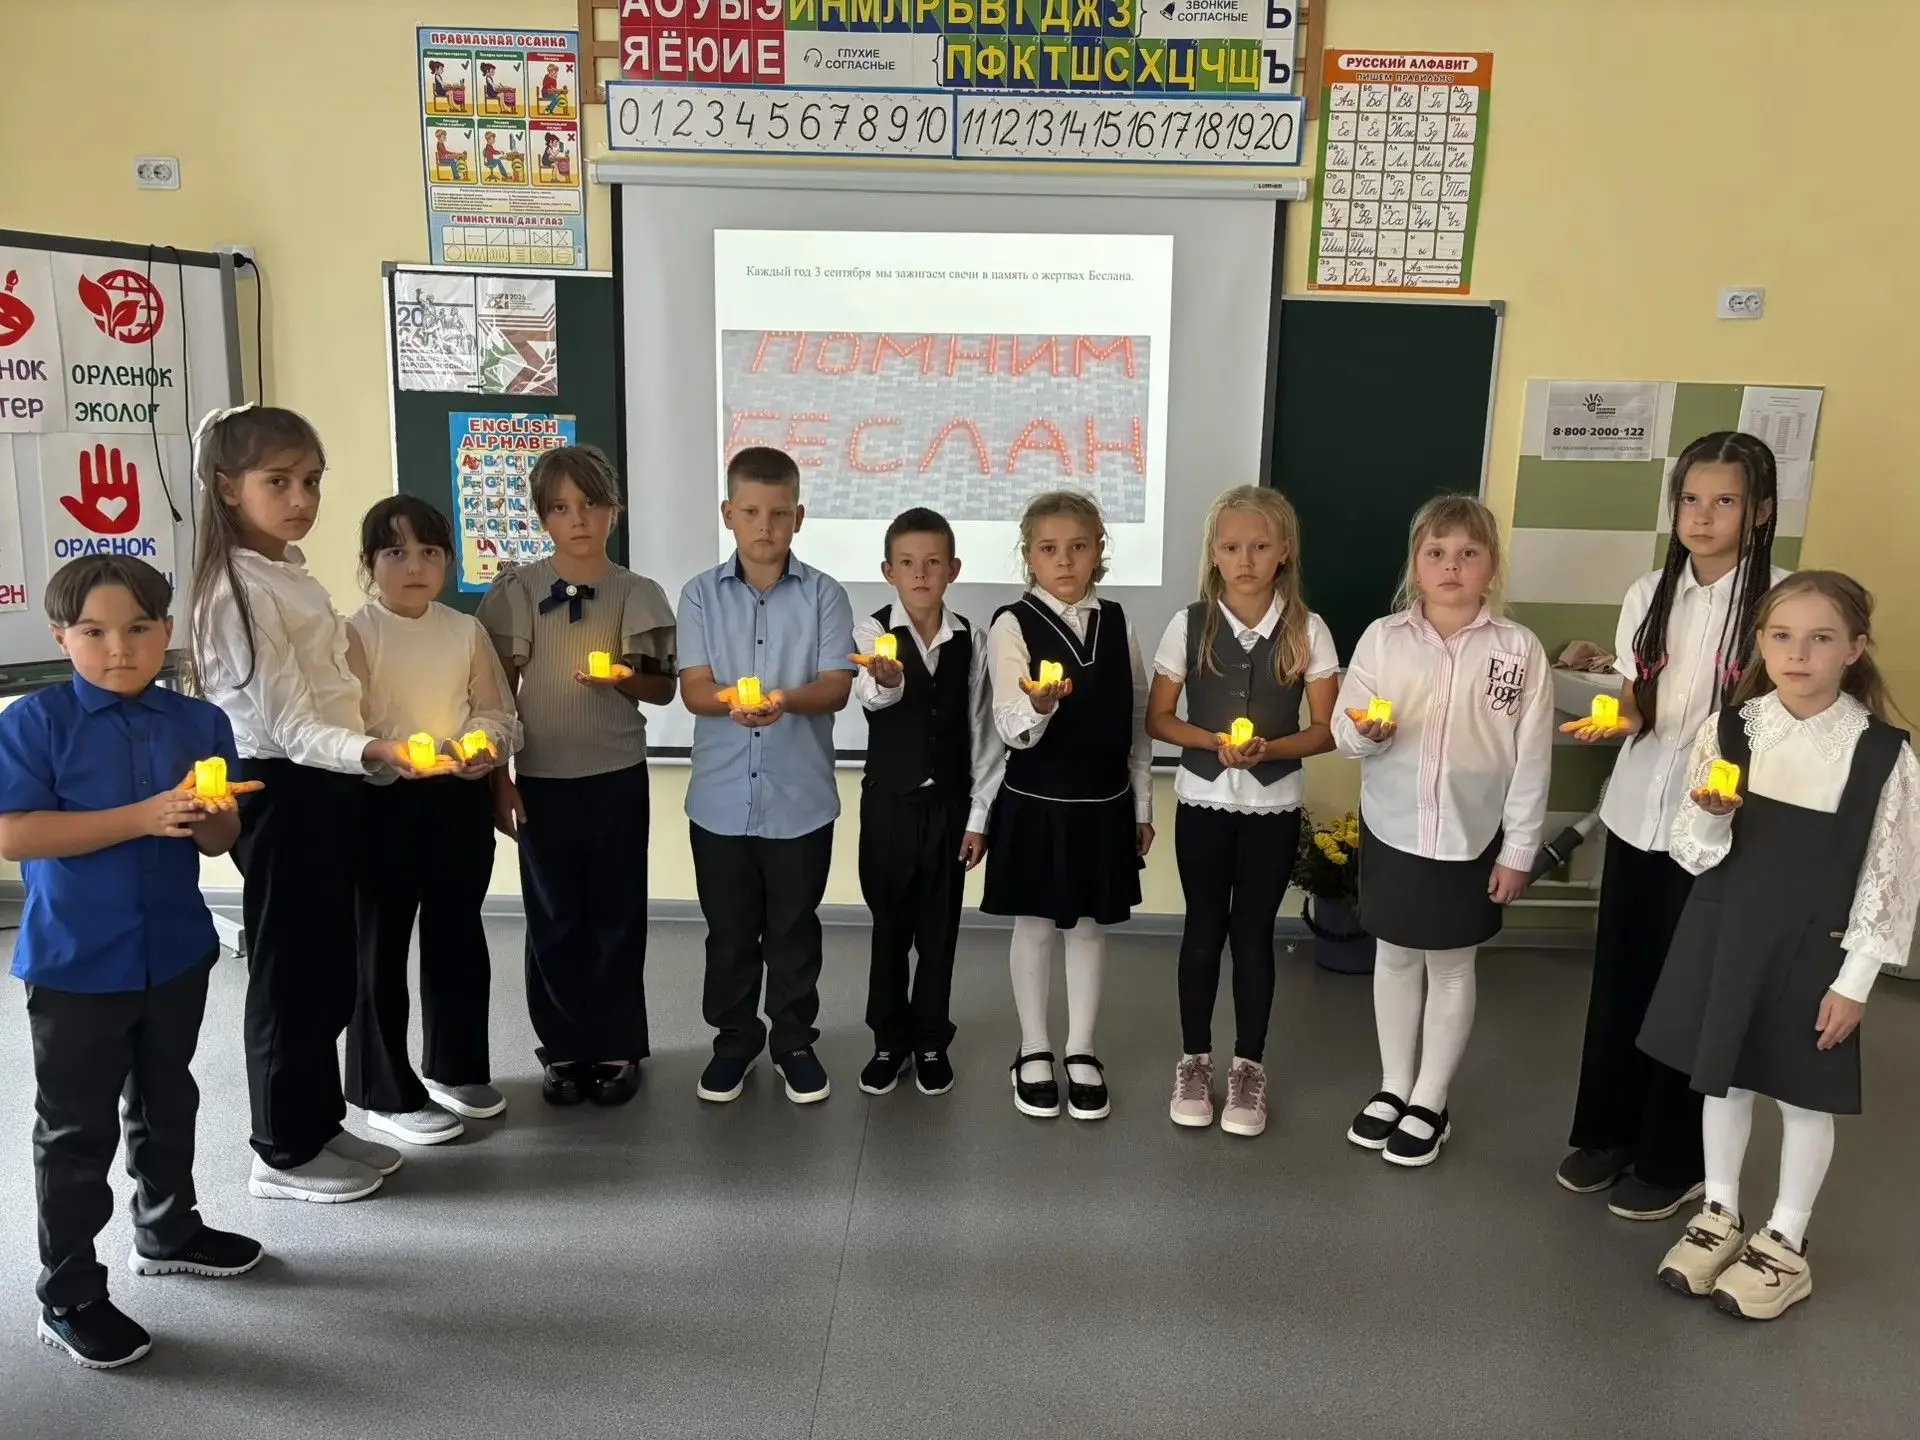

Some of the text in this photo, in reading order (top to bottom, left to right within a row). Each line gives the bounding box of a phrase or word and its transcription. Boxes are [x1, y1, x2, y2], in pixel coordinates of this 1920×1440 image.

[1186, 0, 1239, 10] ЗВОНКИЕ
[1177, 12, 1248, 22] СОГЛАСНЫЕ
[431, 33, 567, 47] ПРАВИЛЬНАЯ ОСАНКА
[837, 48, 880, 59] ГЛУХИЕ
[825, 60, 895, 71] СОГЛАСНЫЕ
[1346, 56, 1470, 70] РУССКИЙ АЛФАВИТ
[1356, 73, 1454, 83] ПИШЕМ ПРАВИЛЬНО
[620, 99, 947, 143] 0 1 2 3 4 5 6 7 8 9 10
[963, 108, 1293, 150] 11 12 13 14 15 16 17 18 19 20
[451, 215, 564, 226] ГИМНАСТИКА ДЛЯ ГЛАЗ
[746, 265, 1134, 283] Каждый год 3 сентября мы зажигаем свечи в память о жертвах Беслана.
[750, 331, 1135, 379] ПОМНИМ
[74, 401, 160, 423] ЭКОЛОГ
[469, 419, 558, 434] ENGLISH
[461, 435, 567, 449] ALPHABET
[1487, 657, 1524, 686] Edi
